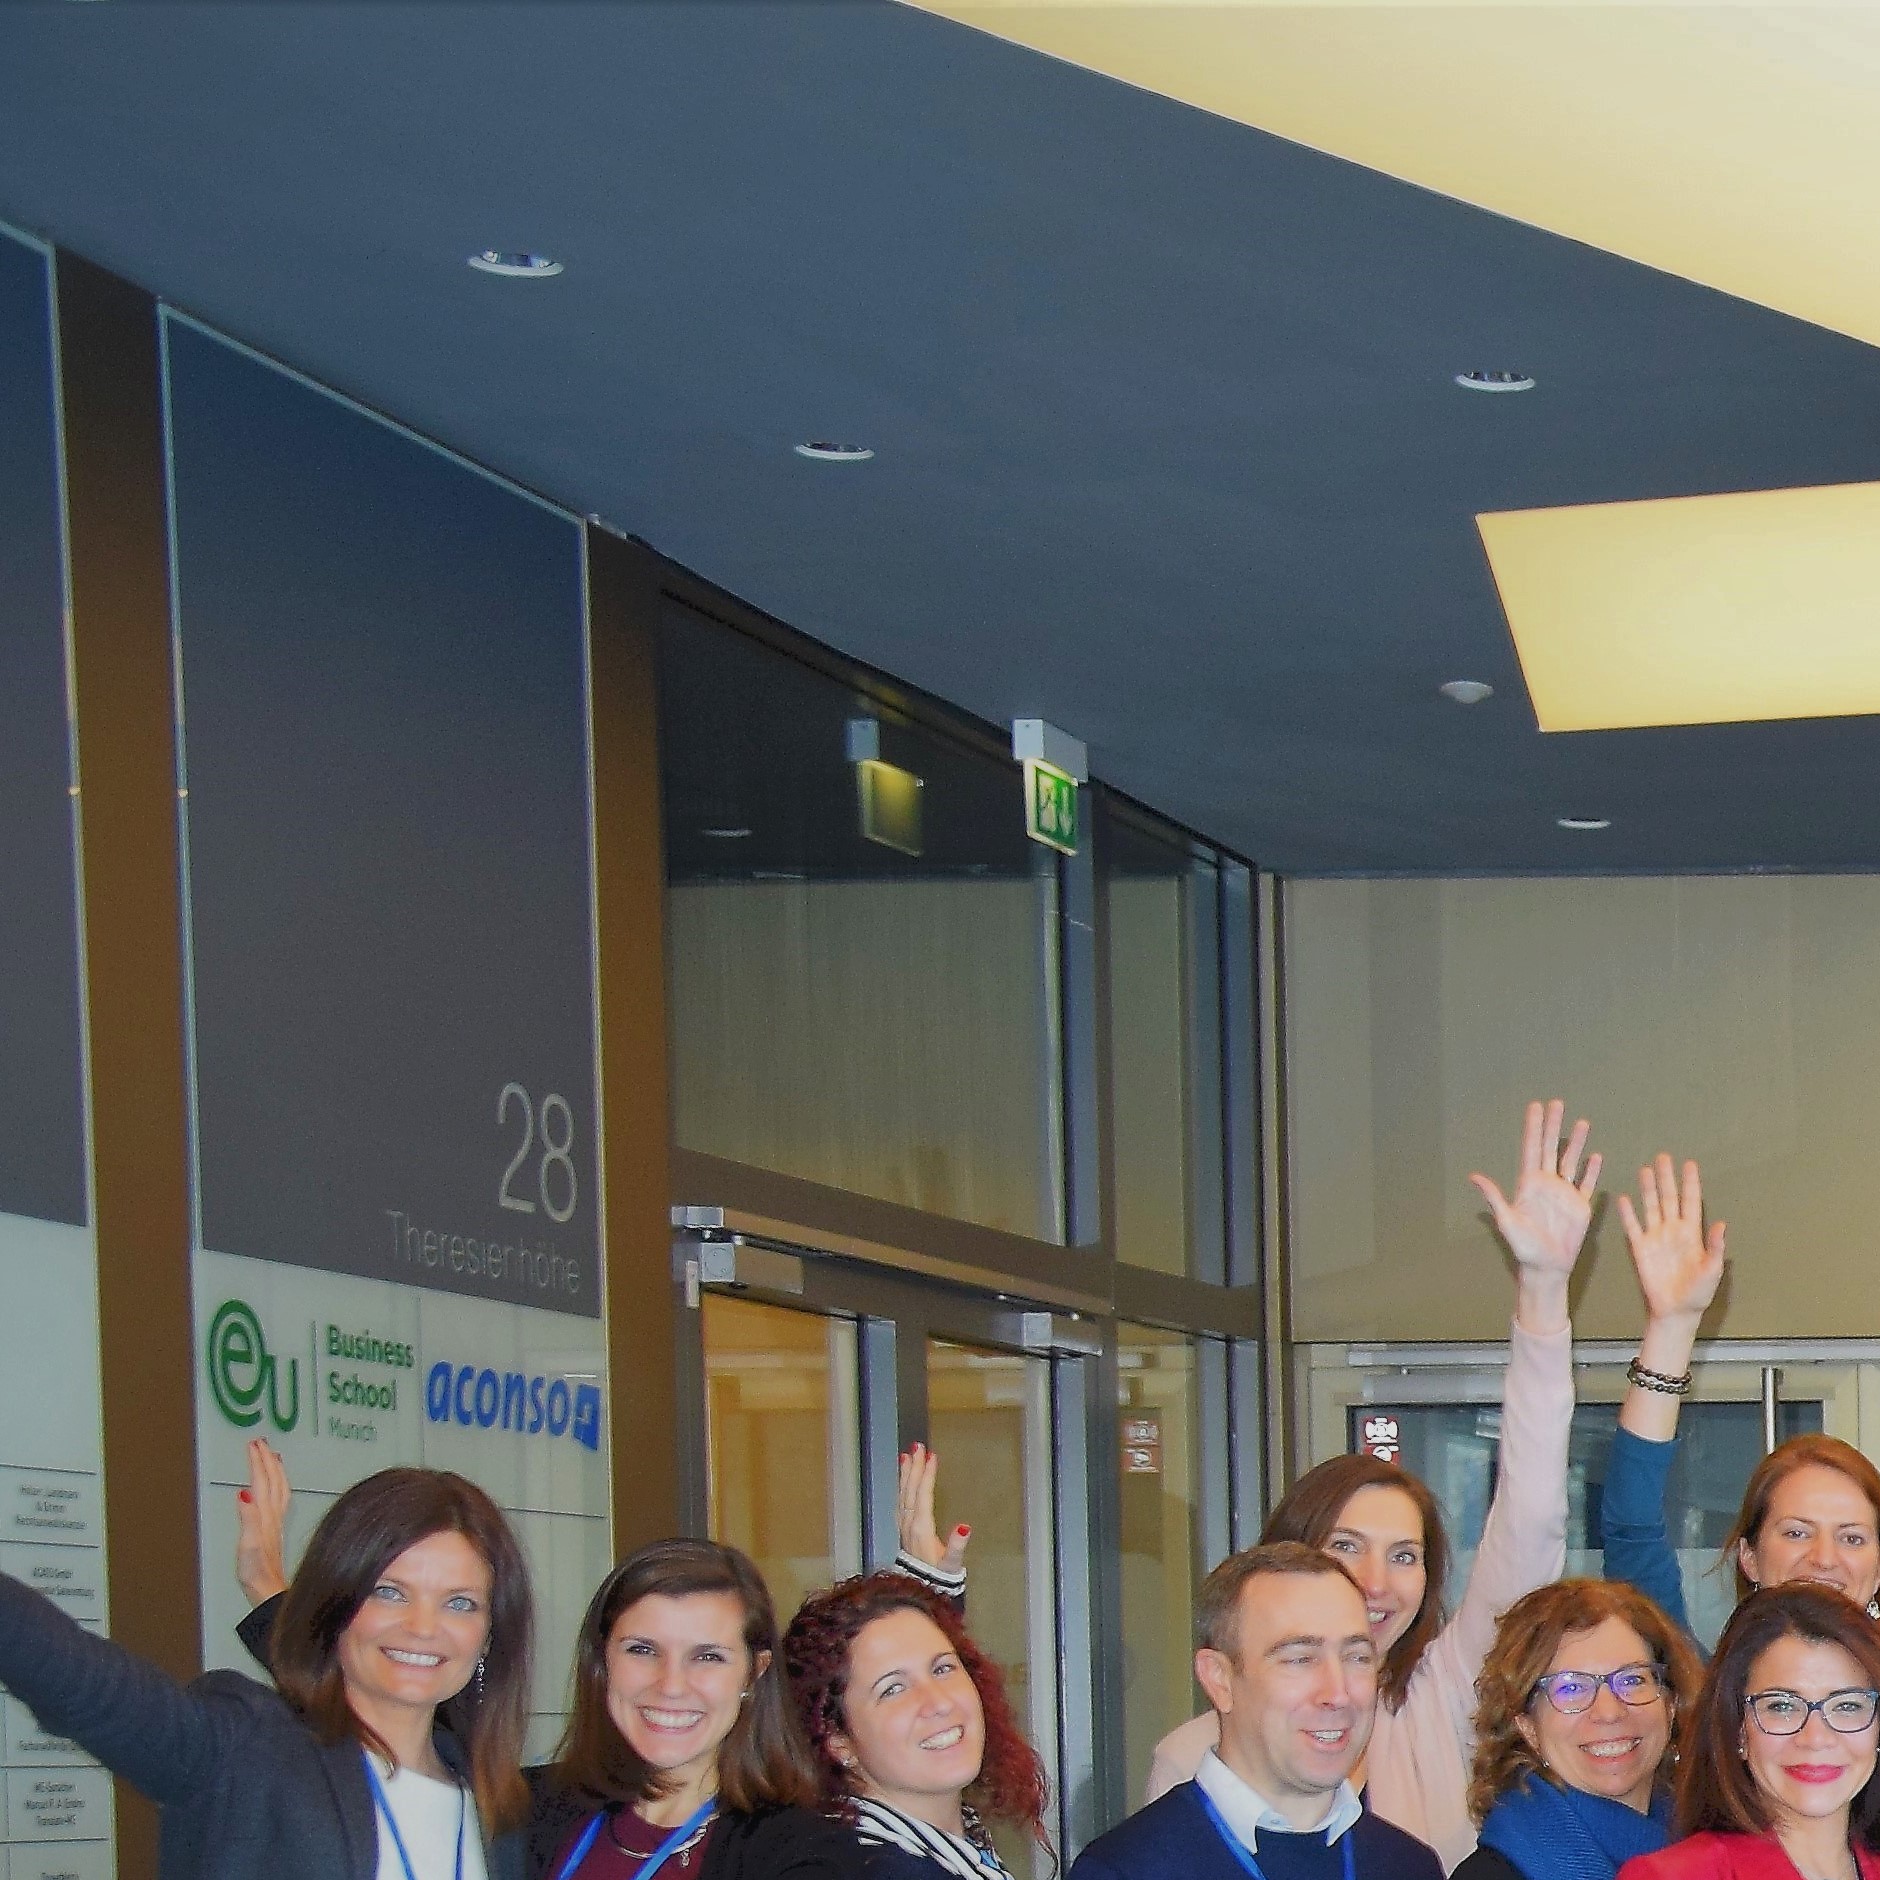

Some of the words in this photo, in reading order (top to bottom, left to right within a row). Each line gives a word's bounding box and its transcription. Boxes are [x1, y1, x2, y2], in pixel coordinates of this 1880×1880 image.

[499, 1082, 578, 1222] 28
[327, 1324, 414, 1368] Business
[328, 1370, 397, 1411] School
[328, 1416, 378, 1442] Munich
